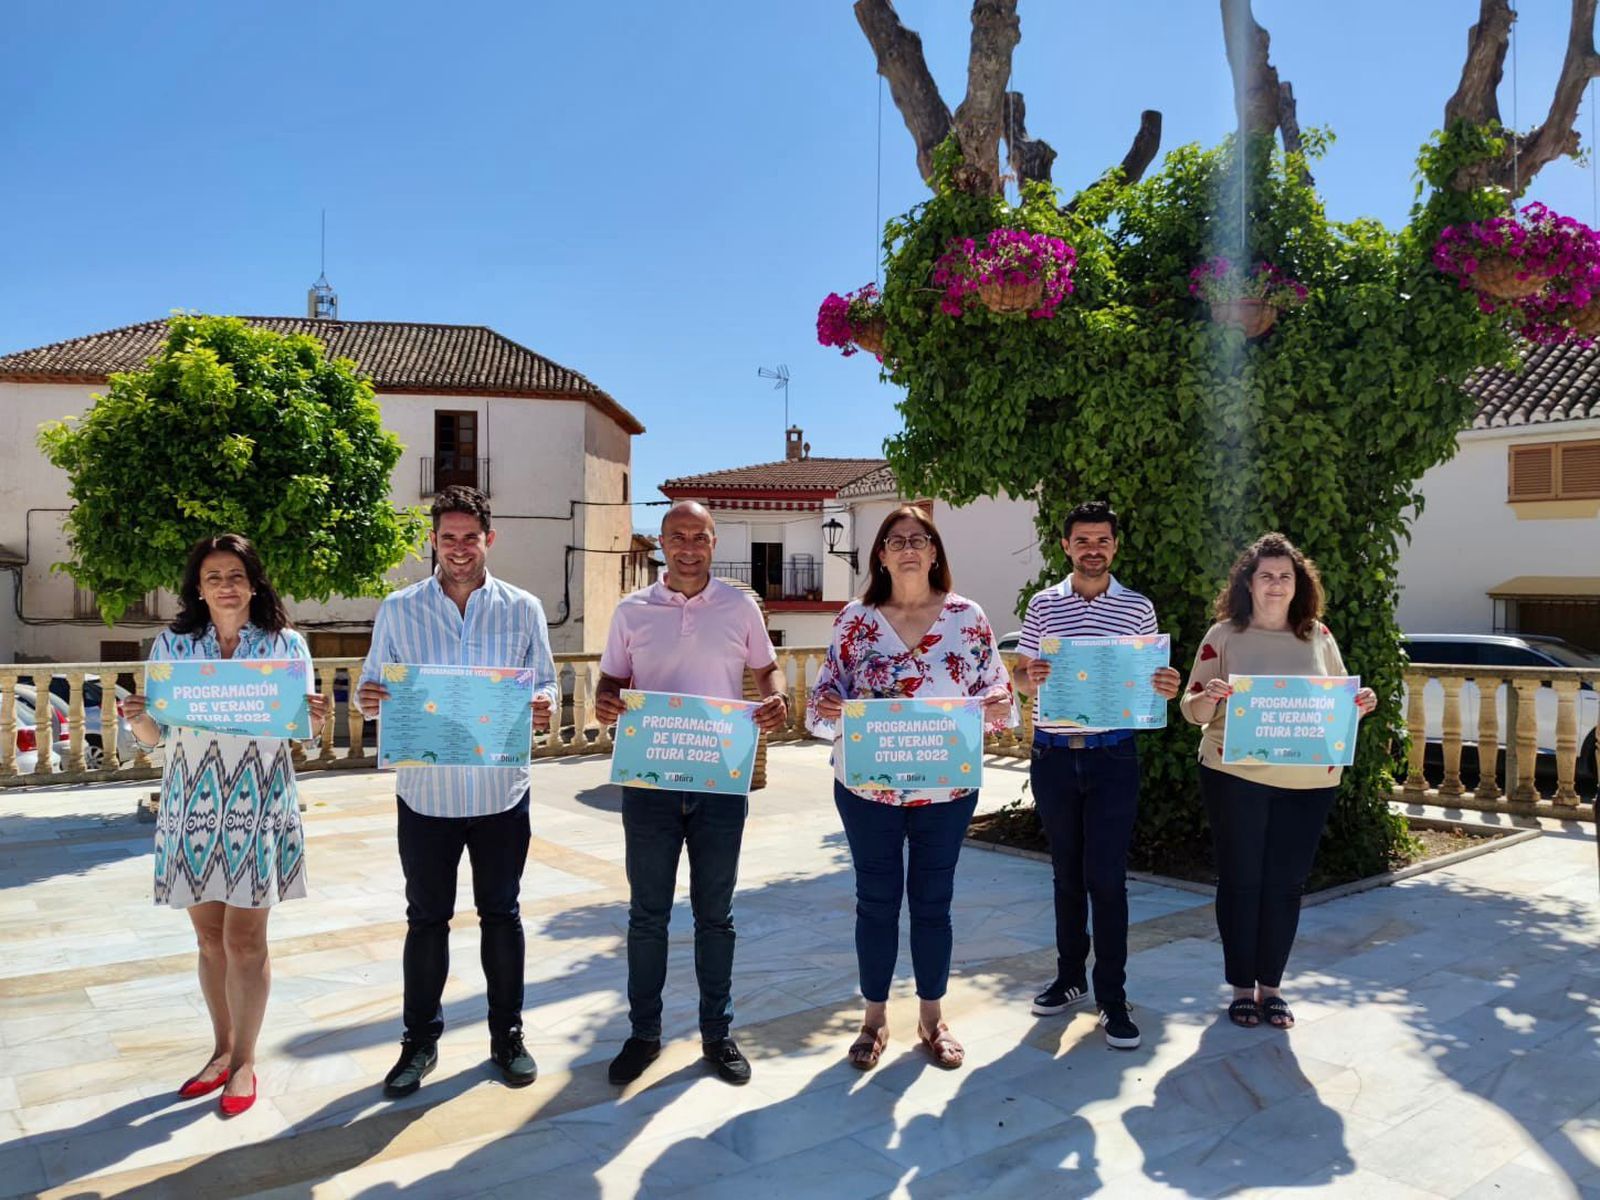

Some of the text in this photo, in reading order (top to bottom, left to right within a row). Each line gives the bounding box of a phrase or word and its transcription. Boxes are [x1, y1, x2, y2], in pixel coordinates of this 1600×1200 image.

[189, 700, 265, 713] DE VERANO
[186, 713, 272, 722] OTURA 2022
[1261, 711, 1322, 723] DE VERANO
[642, 716, 734, 734] PROGRAMACIÓN
[866, 718, 957, 733] PROGRAMACIÓN
[1255, 726, 1325, 738] OTURA 2022
[653, 732, 718, 747] DE VERANO
[879, 735, 943, 747] DE VERANO
[646, 748, 721, 763] OTURA 2022
[875, 749, 949, 762] OTURA 2022
